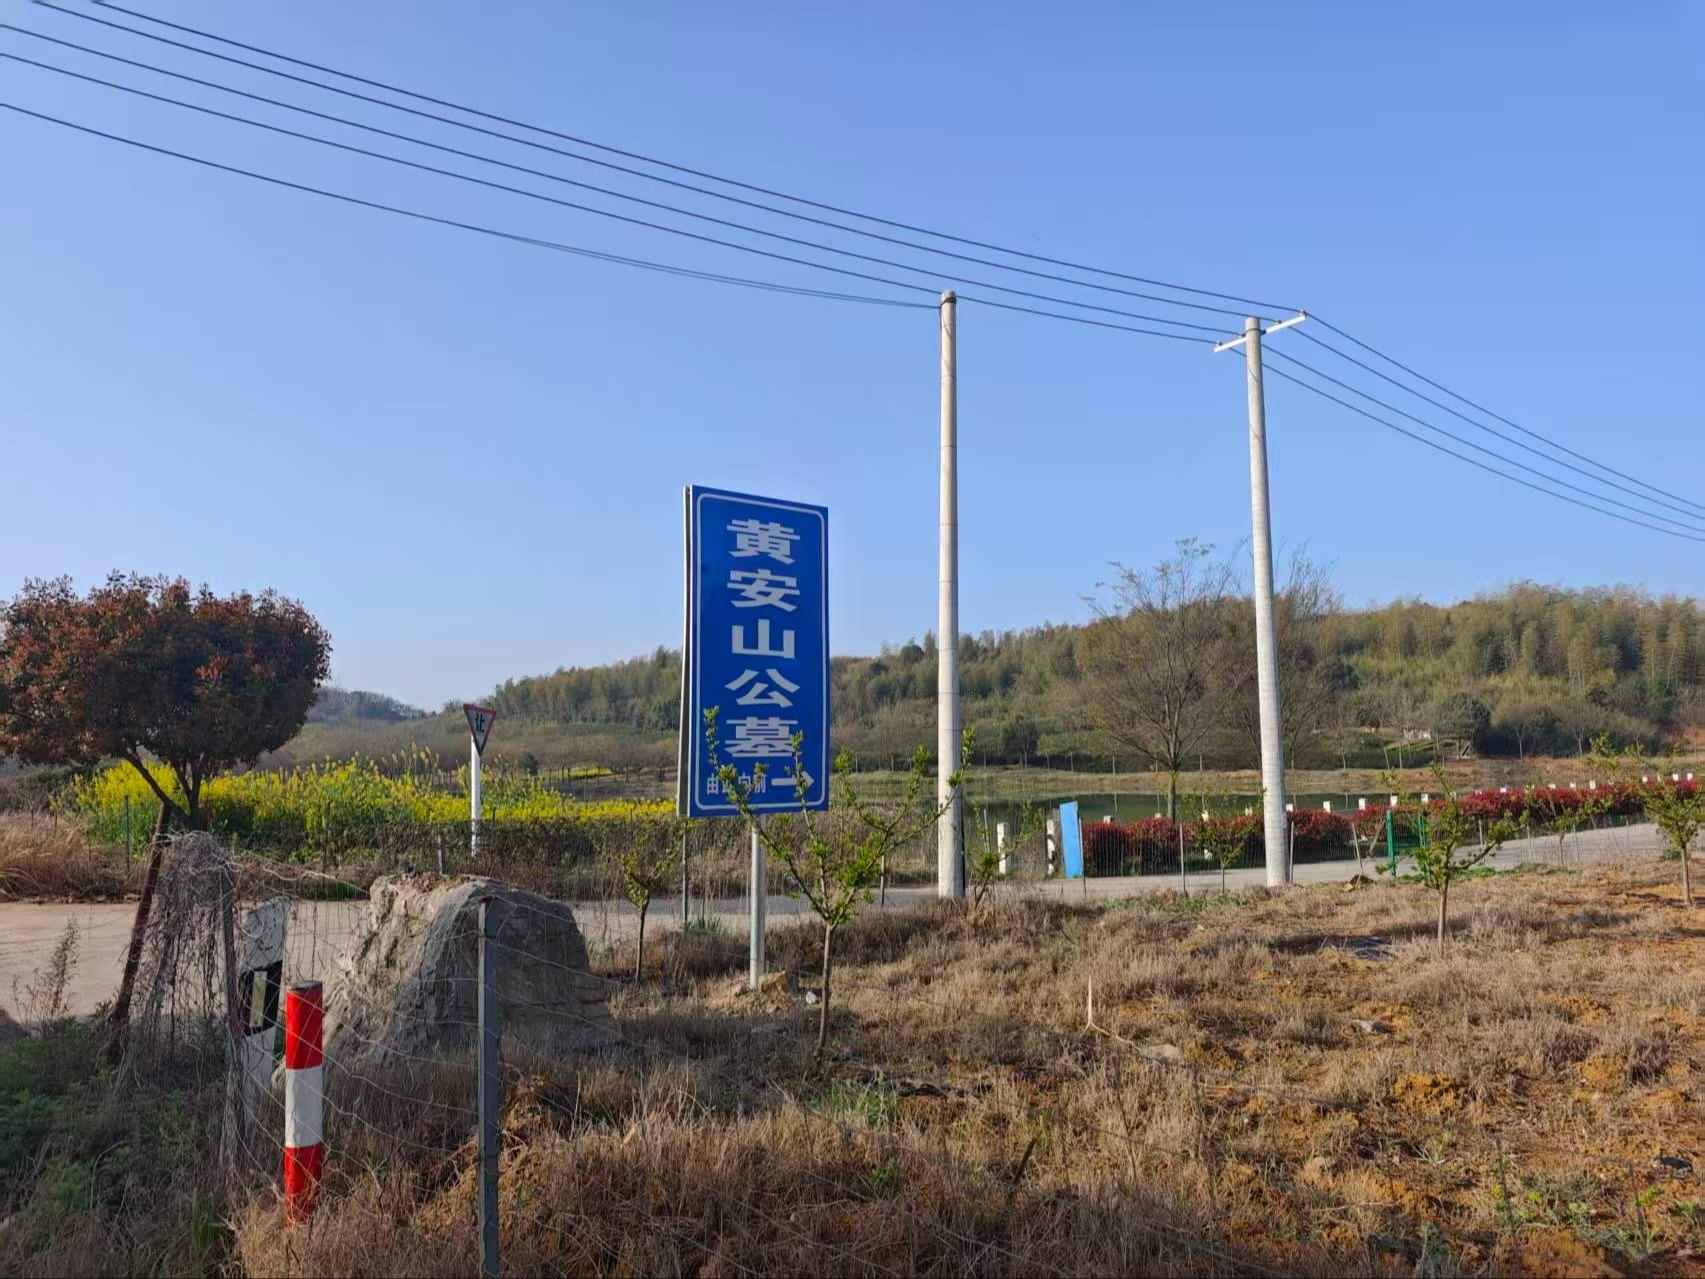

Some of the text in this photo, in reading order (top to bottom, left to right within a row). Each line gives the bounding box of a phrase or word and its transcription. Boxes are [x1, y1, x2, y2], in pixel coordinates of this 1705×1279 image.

[725, 519, 800, 757] 黄安山公墓
